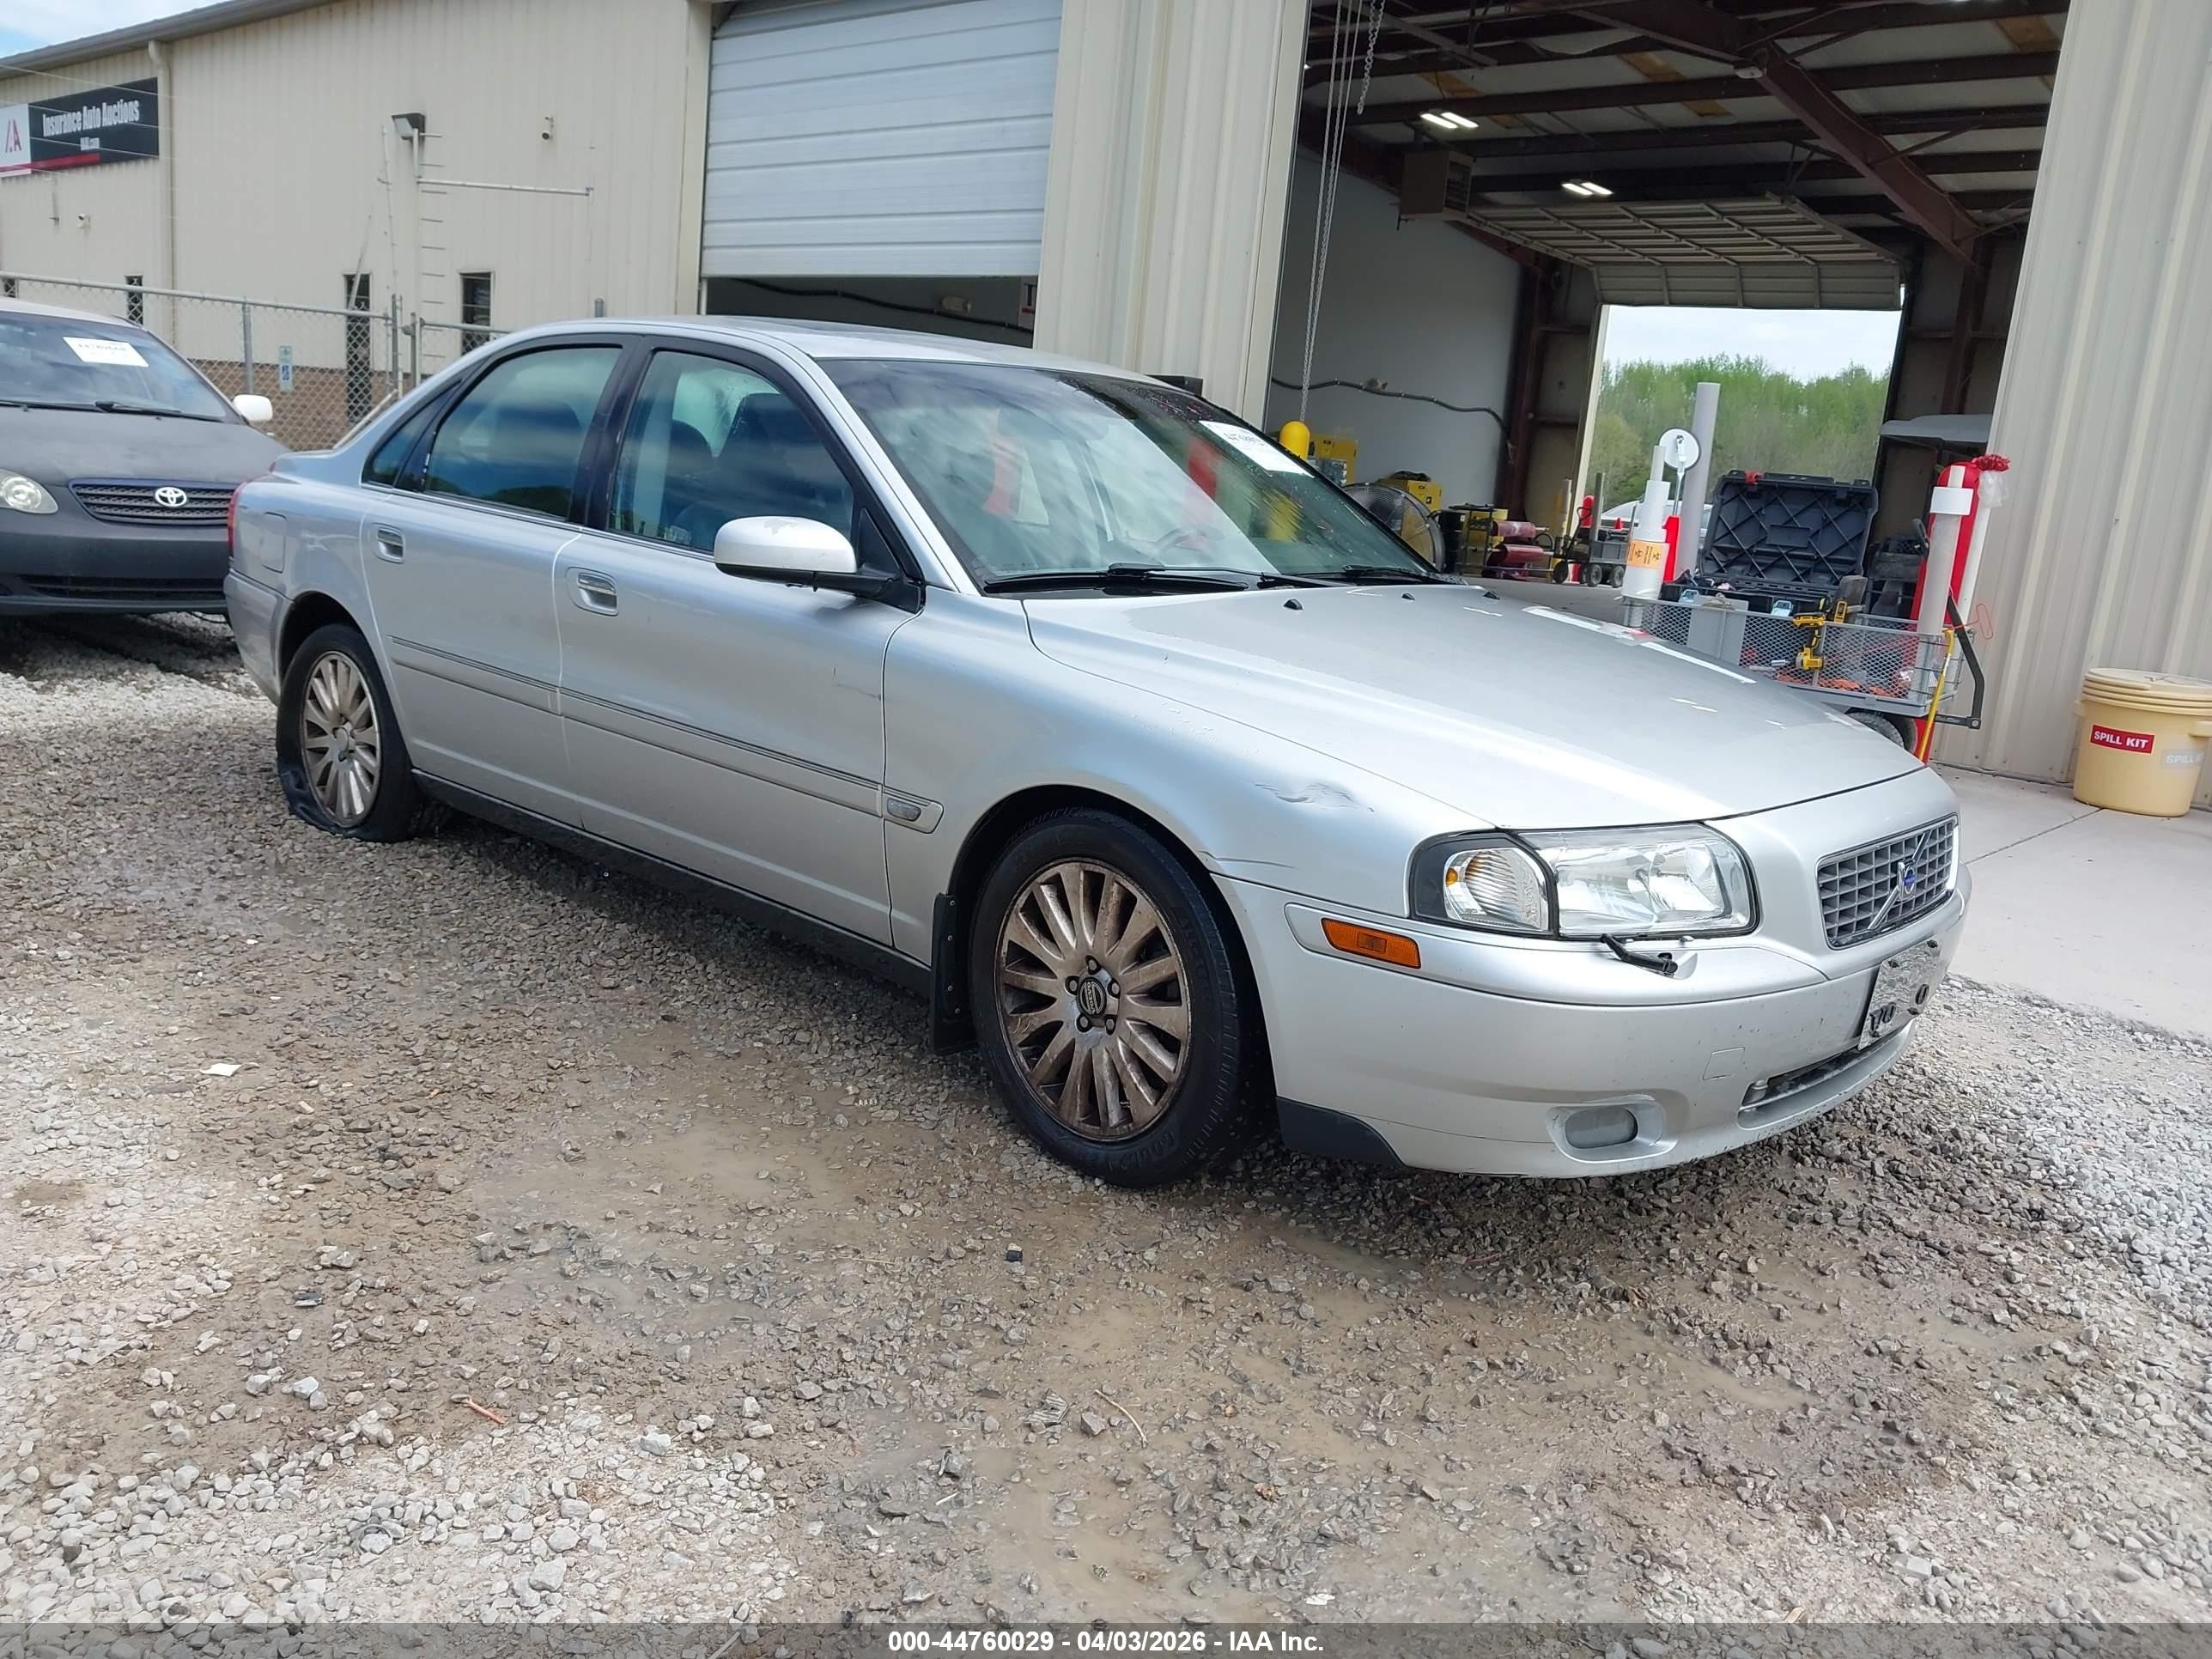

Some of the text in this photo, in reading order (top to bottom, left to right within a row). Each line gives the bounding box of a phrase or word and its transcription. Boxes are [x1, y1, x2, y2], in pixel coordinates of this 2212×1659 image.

[43, 98, 139, 137] Insurance Auto Auctions
[2094, 730, 2148, 749] SPILL KIT
[2166, 755, 2194, 763] SPILL
[1086, 981, 1096, 1014] VOLVO
